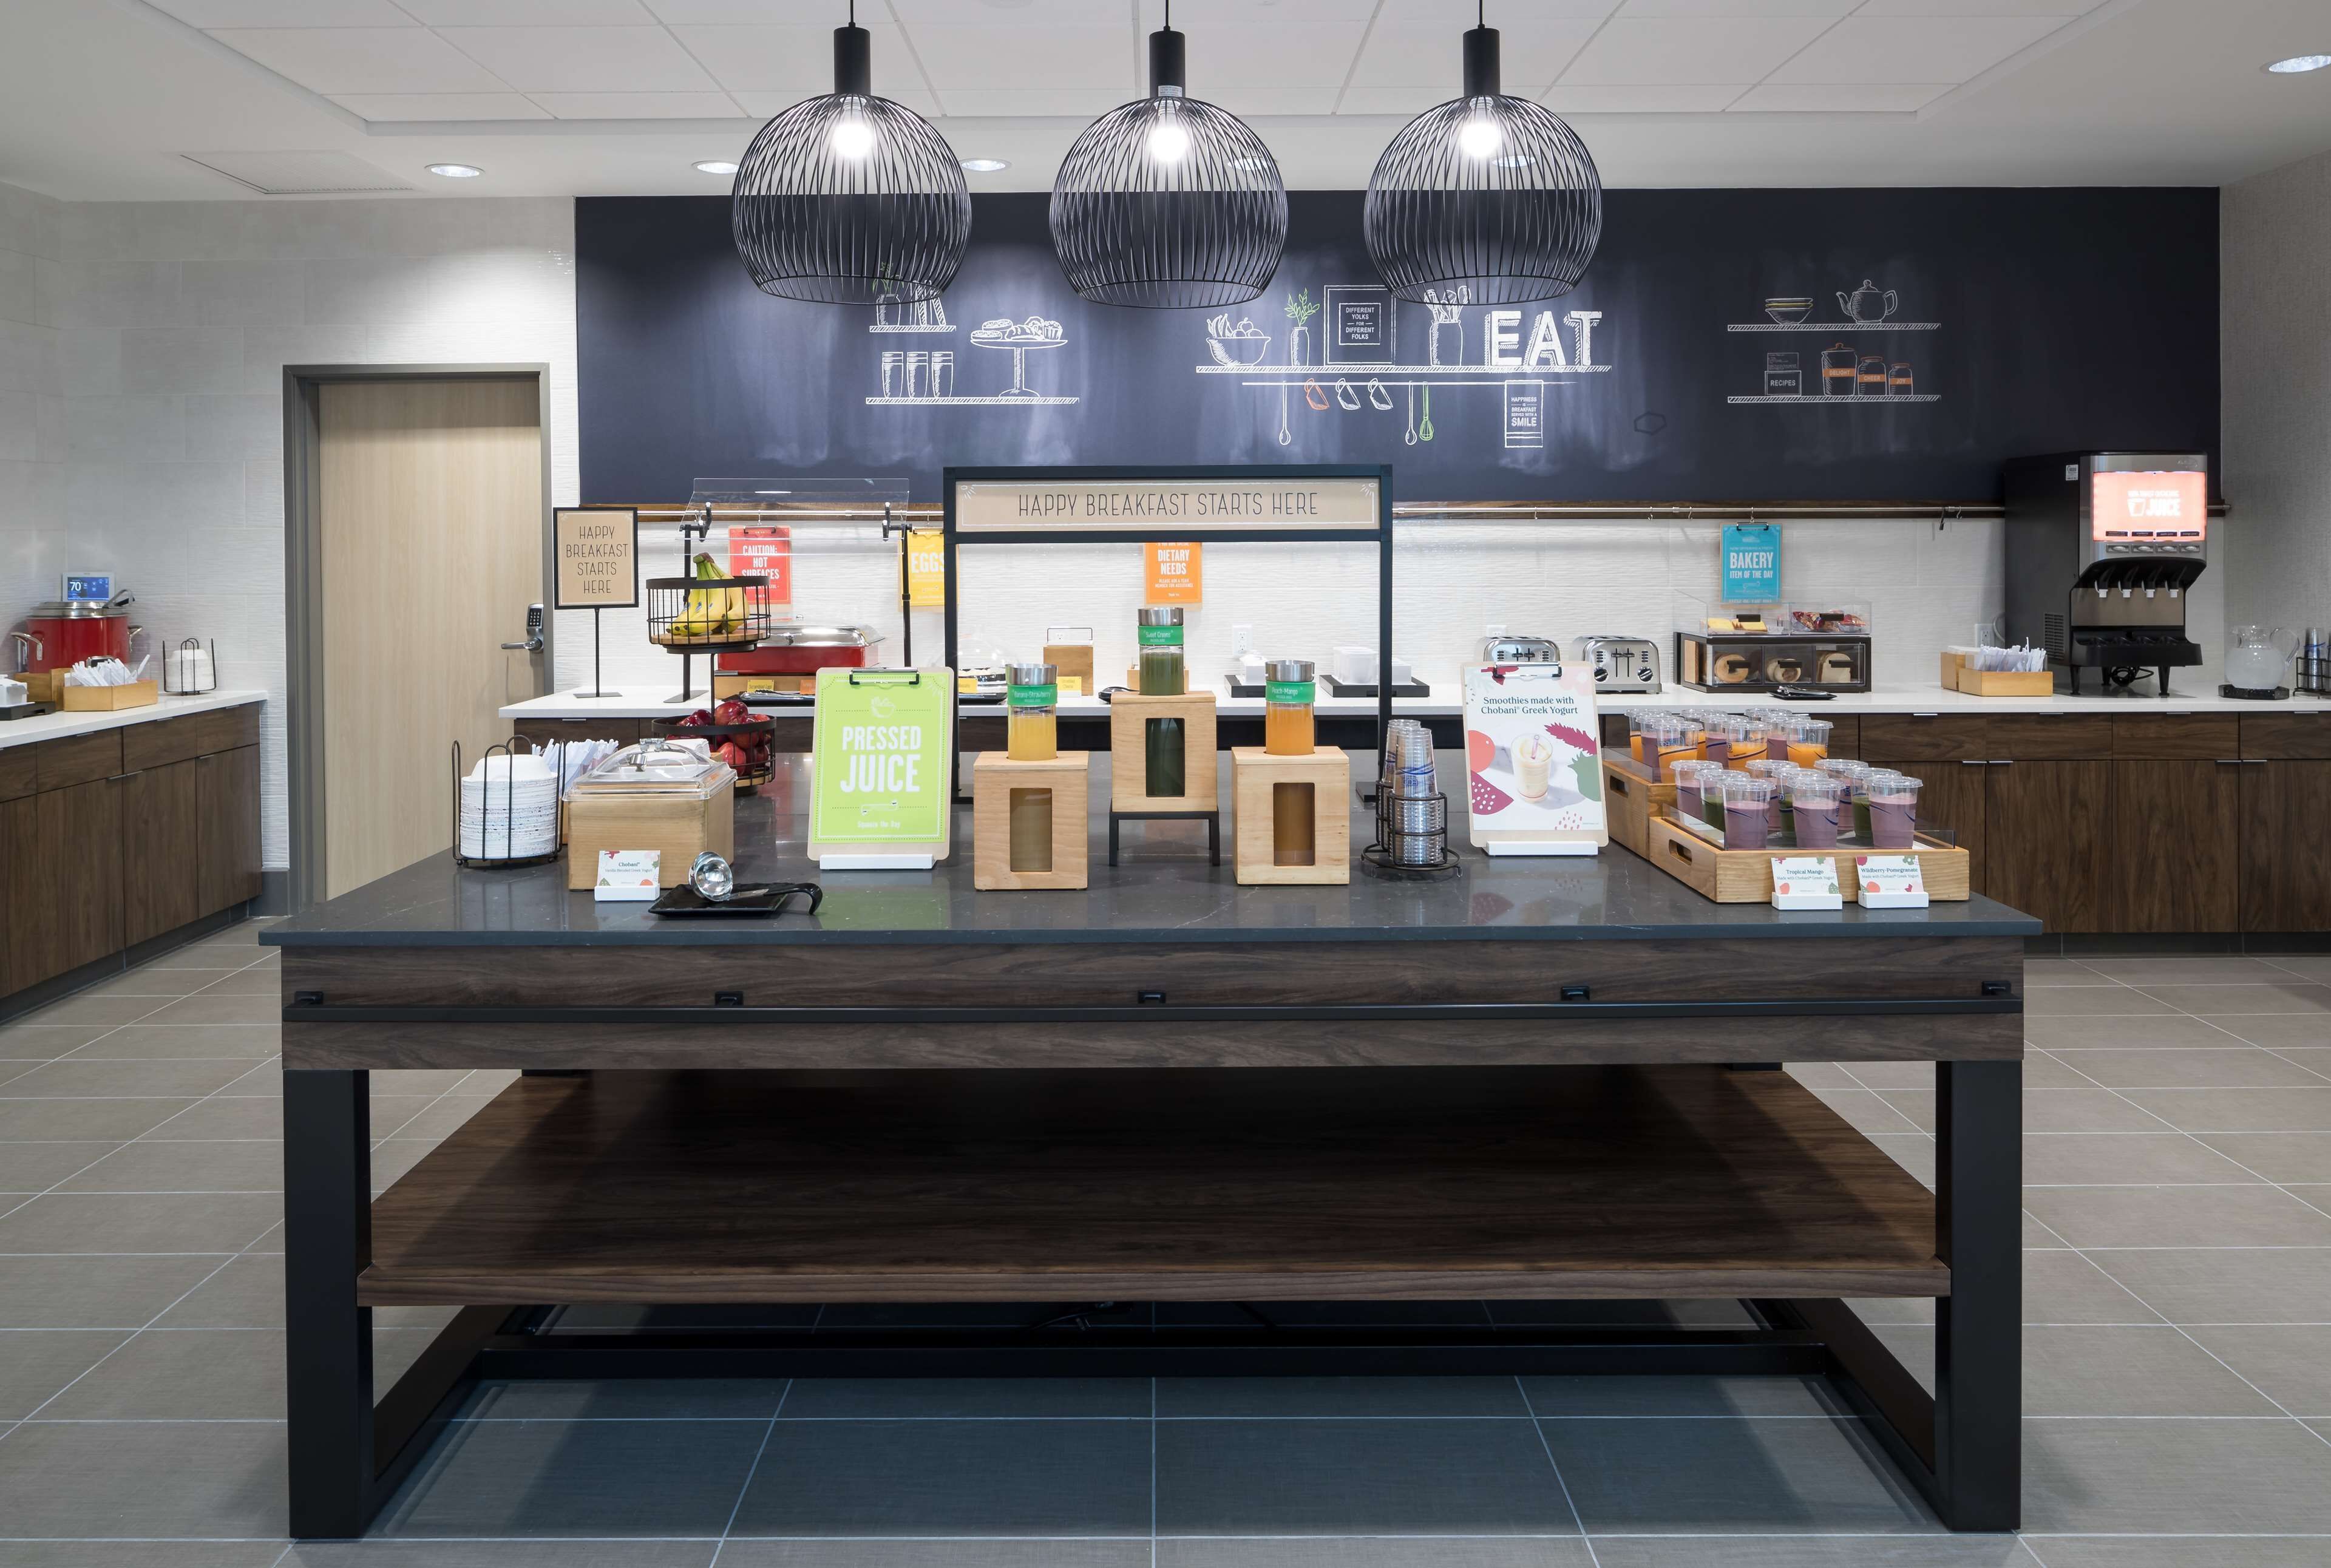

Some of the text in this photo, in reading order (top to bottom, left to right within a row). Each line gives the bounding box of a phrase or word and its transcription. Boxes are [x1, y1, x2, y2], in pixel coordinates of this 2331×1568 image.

[1488, 311, 1603, 365] EAT
[1511, 417, 1537, 427] SMILE
[1019, 492, 1318, 517] HAPPY BREAKFAST STARTS HERE
[579, 526, 615, 539] HAPPY
[566, 543, 628, 558] BREAKFAST
[742, 545, 777, 555] CAUTION:
[1158, 549, 1190, 562] DIETARY
[753, 557, 768, 568] HOT
[1730, 552, 1773, 569] BAKERY
[577, 562, 617, 576] STARTS
[1161, 563, 1187, 575] NEEDS
[583, 580, 611, 594] HERE
[1550, 707, 1578, 715] Yogurt
[842, 725, 921, 750] PRESSED
[840, 754, 921, 793] JUICE
